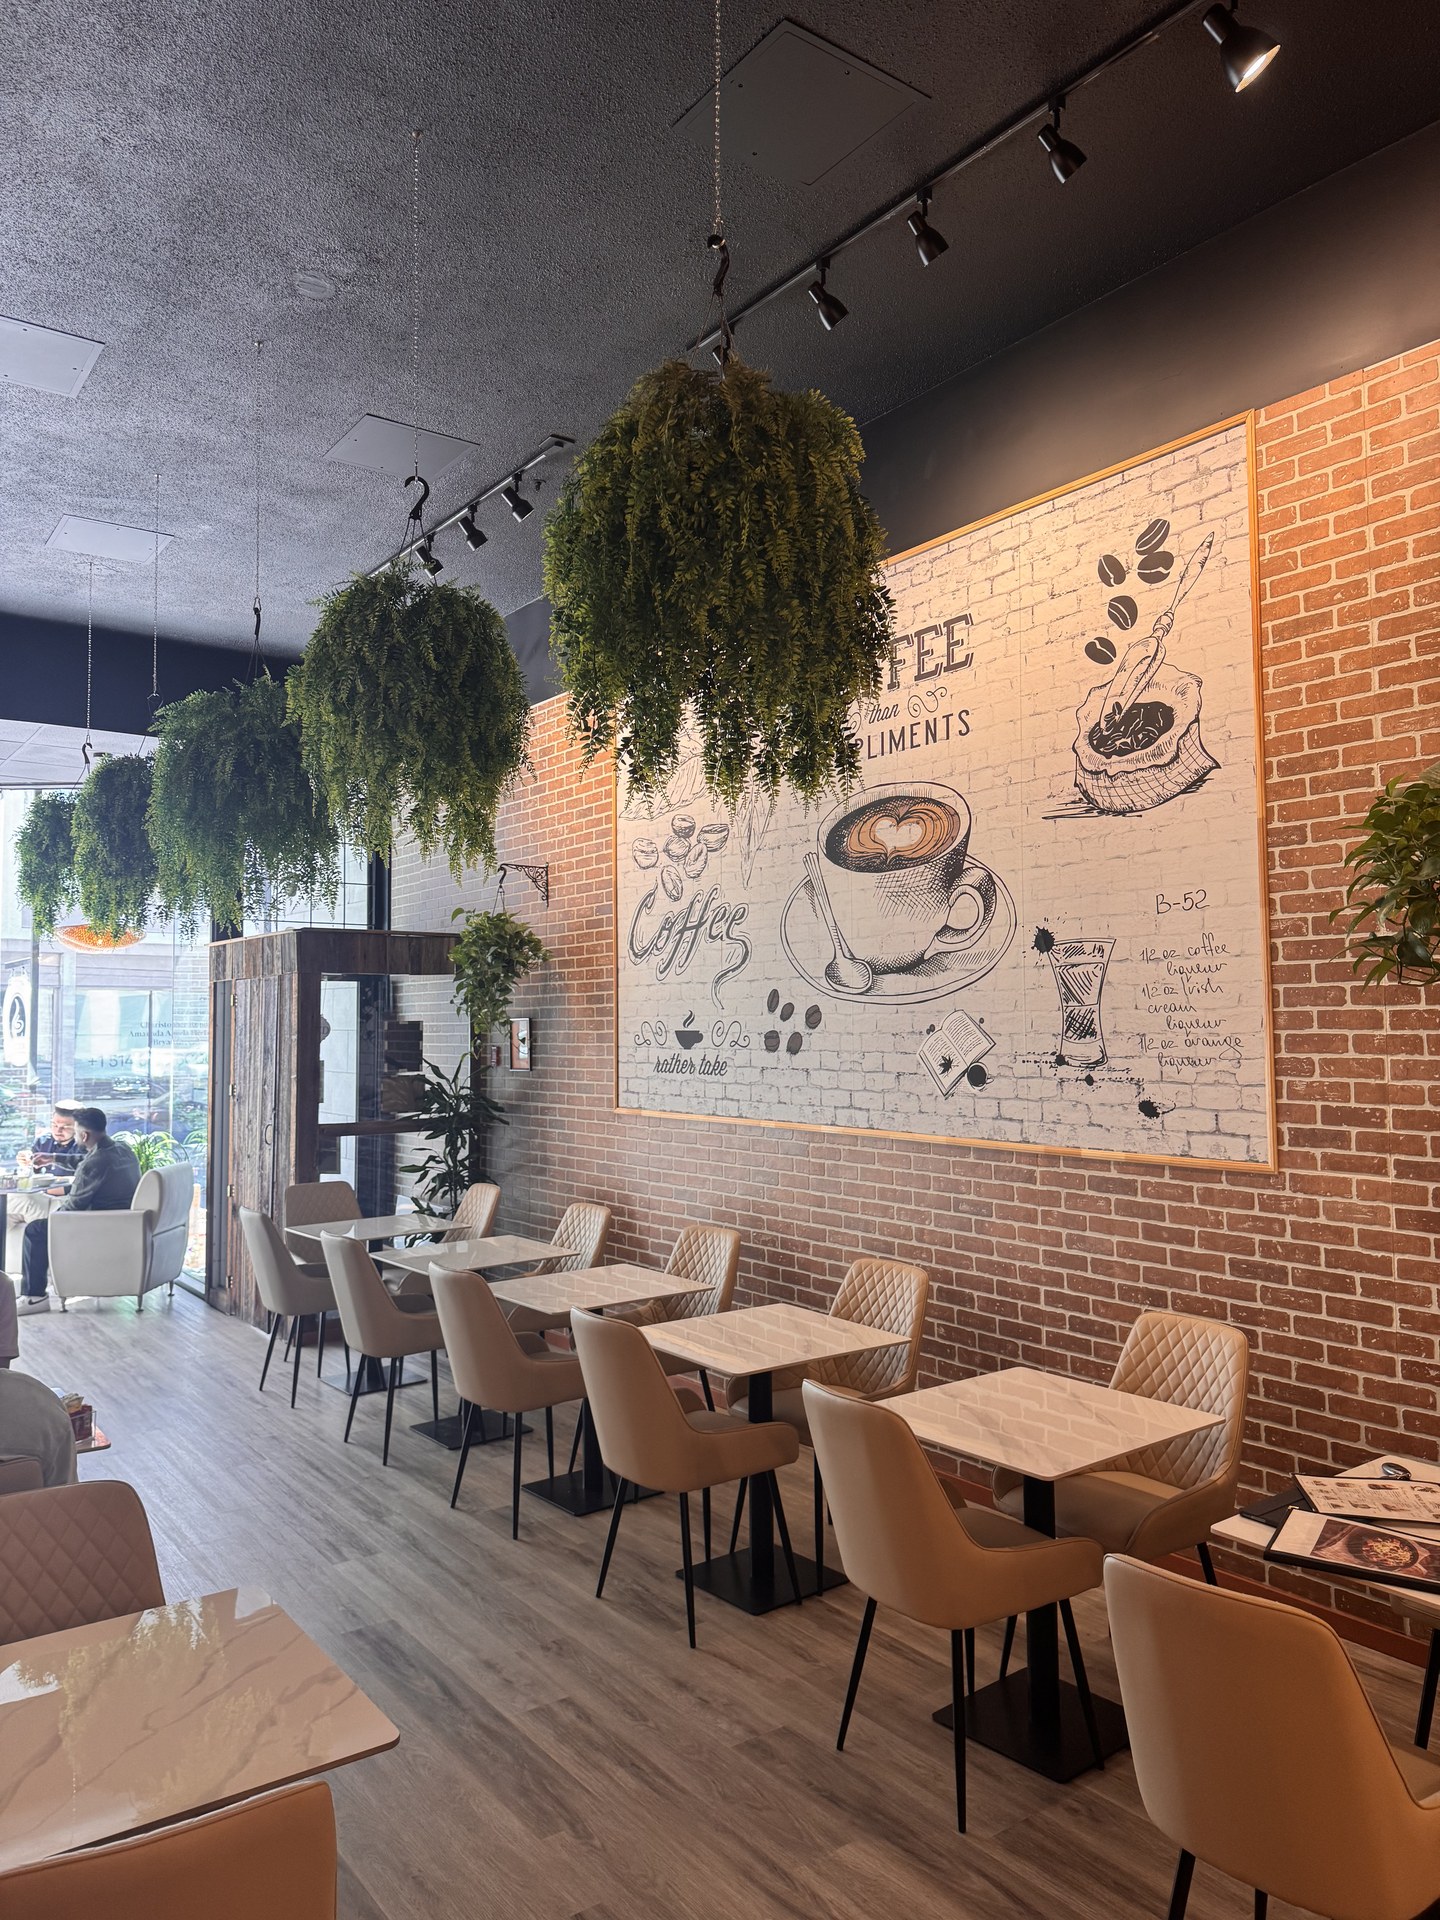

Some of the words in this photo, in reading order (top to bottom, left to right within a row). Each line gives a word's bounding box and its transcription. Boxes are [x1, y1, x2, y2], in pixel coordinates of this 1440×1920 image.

[886, 612, 974, 691] FEE
[868, 703, 901, 725] than
[1155, 889, 1211, 915] B-52
[628, 877, 753, 1010] Coffee
[1187, 932, 1231, 957] coffee
[1166, 961, 1228, 983] liqueur
[1147, 1002, 1198, 1014] cream
[1165, 1015, 1227, 1037] liqueur
[1184, 1035, 1245, 1061] orange
[652, 1053, 696, 1075] rather
[698, 1054, 729, 1077] take
